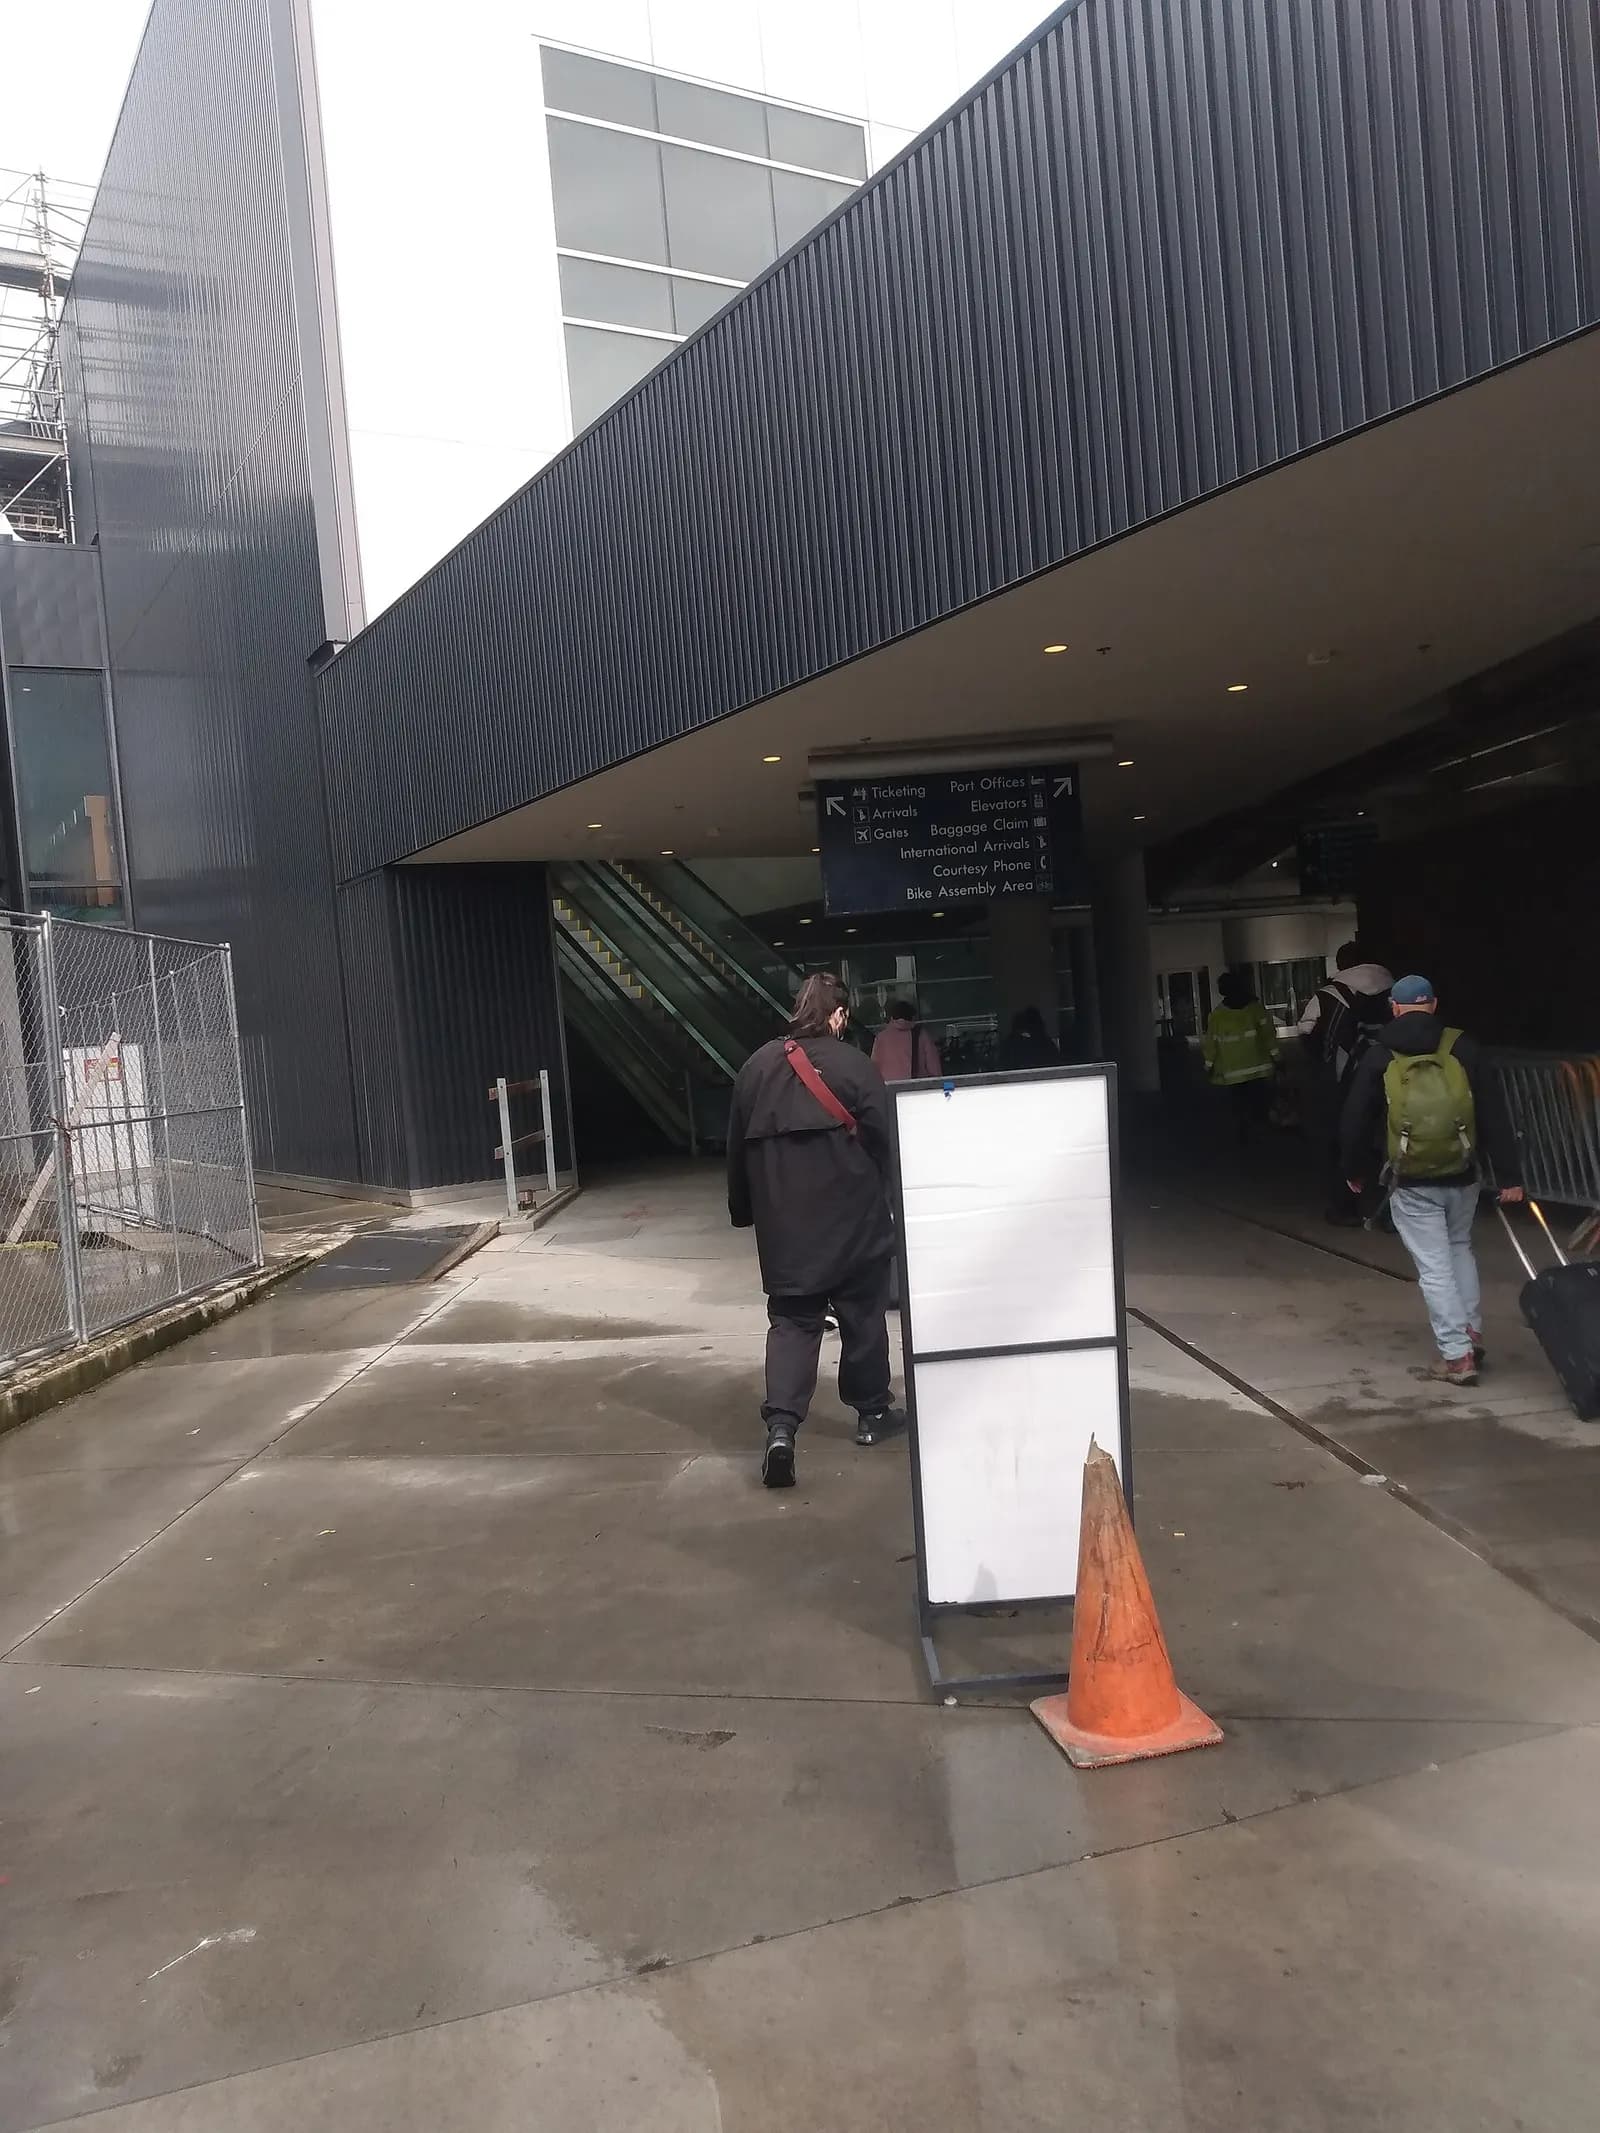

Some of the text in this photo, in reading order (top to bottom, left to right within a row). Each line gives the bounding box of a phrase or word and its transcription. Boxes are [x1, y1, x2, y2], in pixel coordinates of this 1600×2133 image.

[871, 785, 926, 799] Ticketing
[949, 776, 1026, 793] Port Offices
[872, 805, 918, 820] Arrivals
[971, 797, 1027, 813] Elevators
[874, 828, 909, 841] Gates
[930, 818, 1029, 838] Baggage Claim
[900, 837, 1030, 860] International Arrivals
[933, 859, 1032, 879] Courtesy Phone
[907, 880, 1033, 900] Bike Assembly Area
